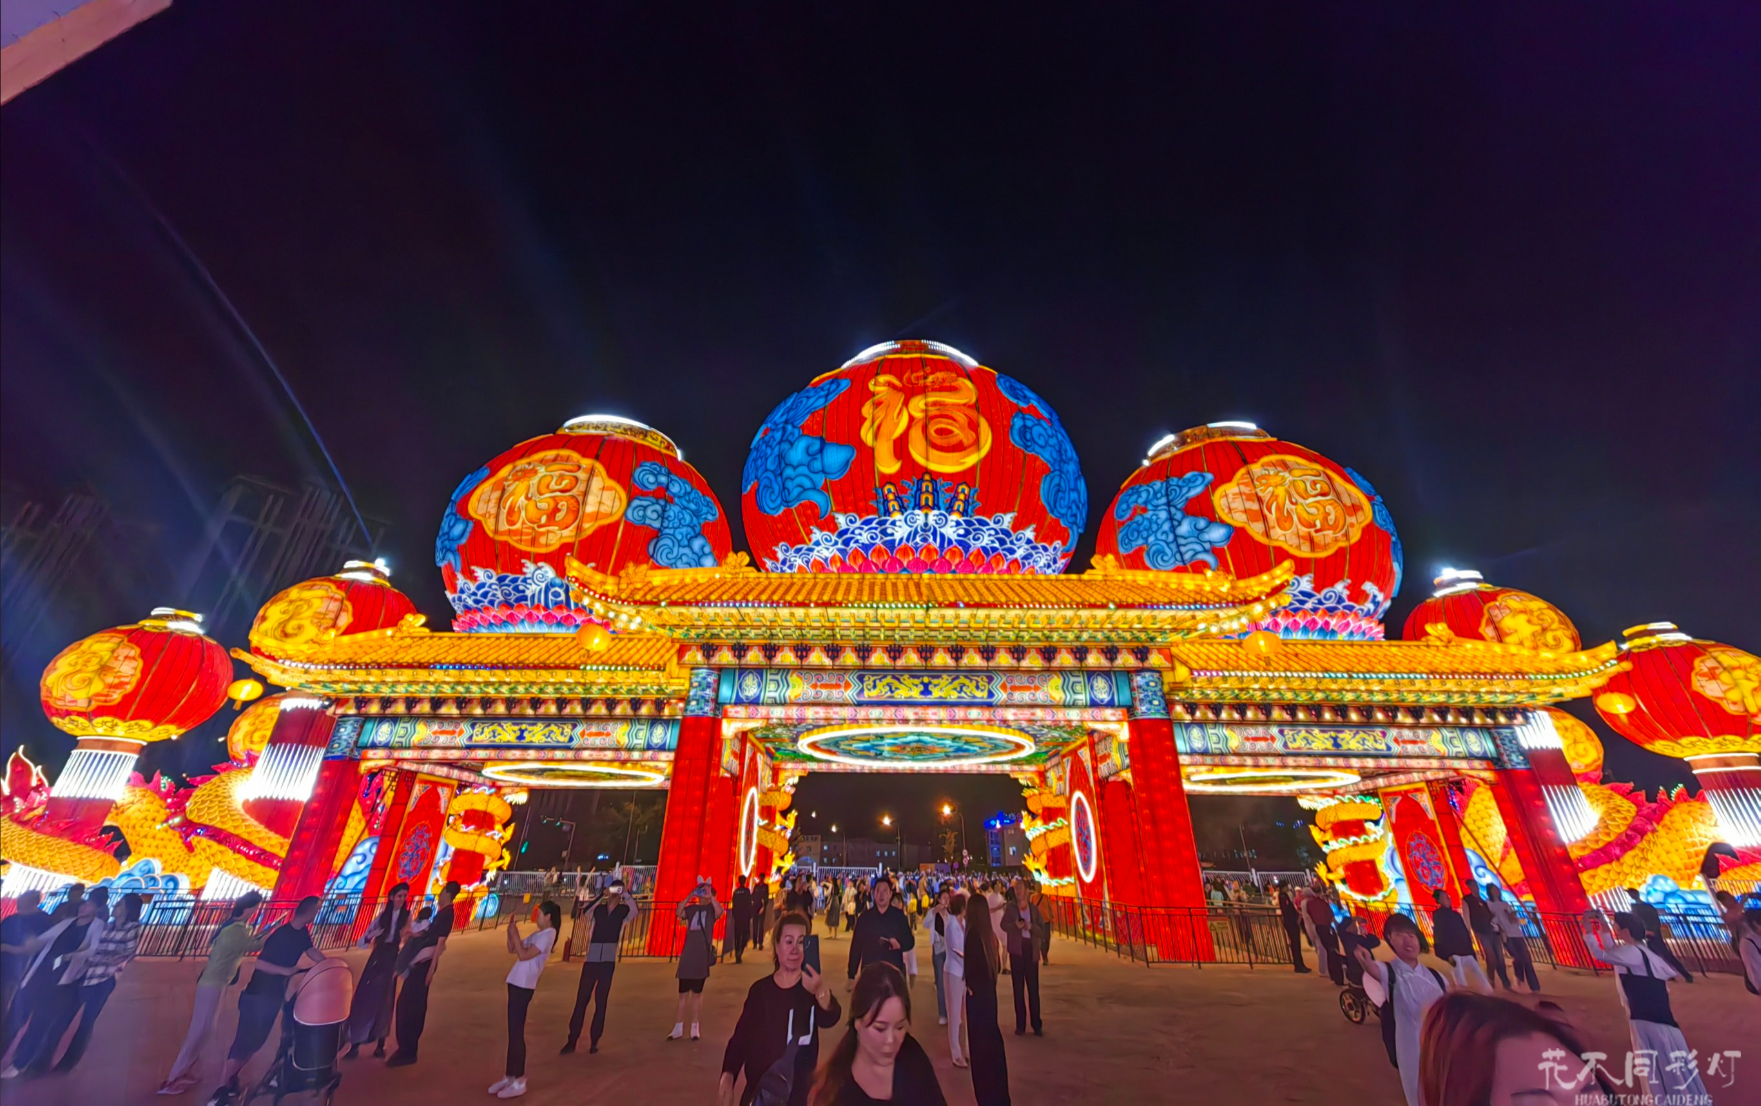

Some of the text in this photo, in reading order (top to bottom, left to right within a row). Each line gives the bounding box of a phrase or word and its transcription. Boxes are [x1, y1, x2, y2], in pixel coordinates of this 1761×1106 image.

[860, 370, 993, 475] 福
[500, 459, 582, 531] 福
[1254, 468, 1347, 535] 福
